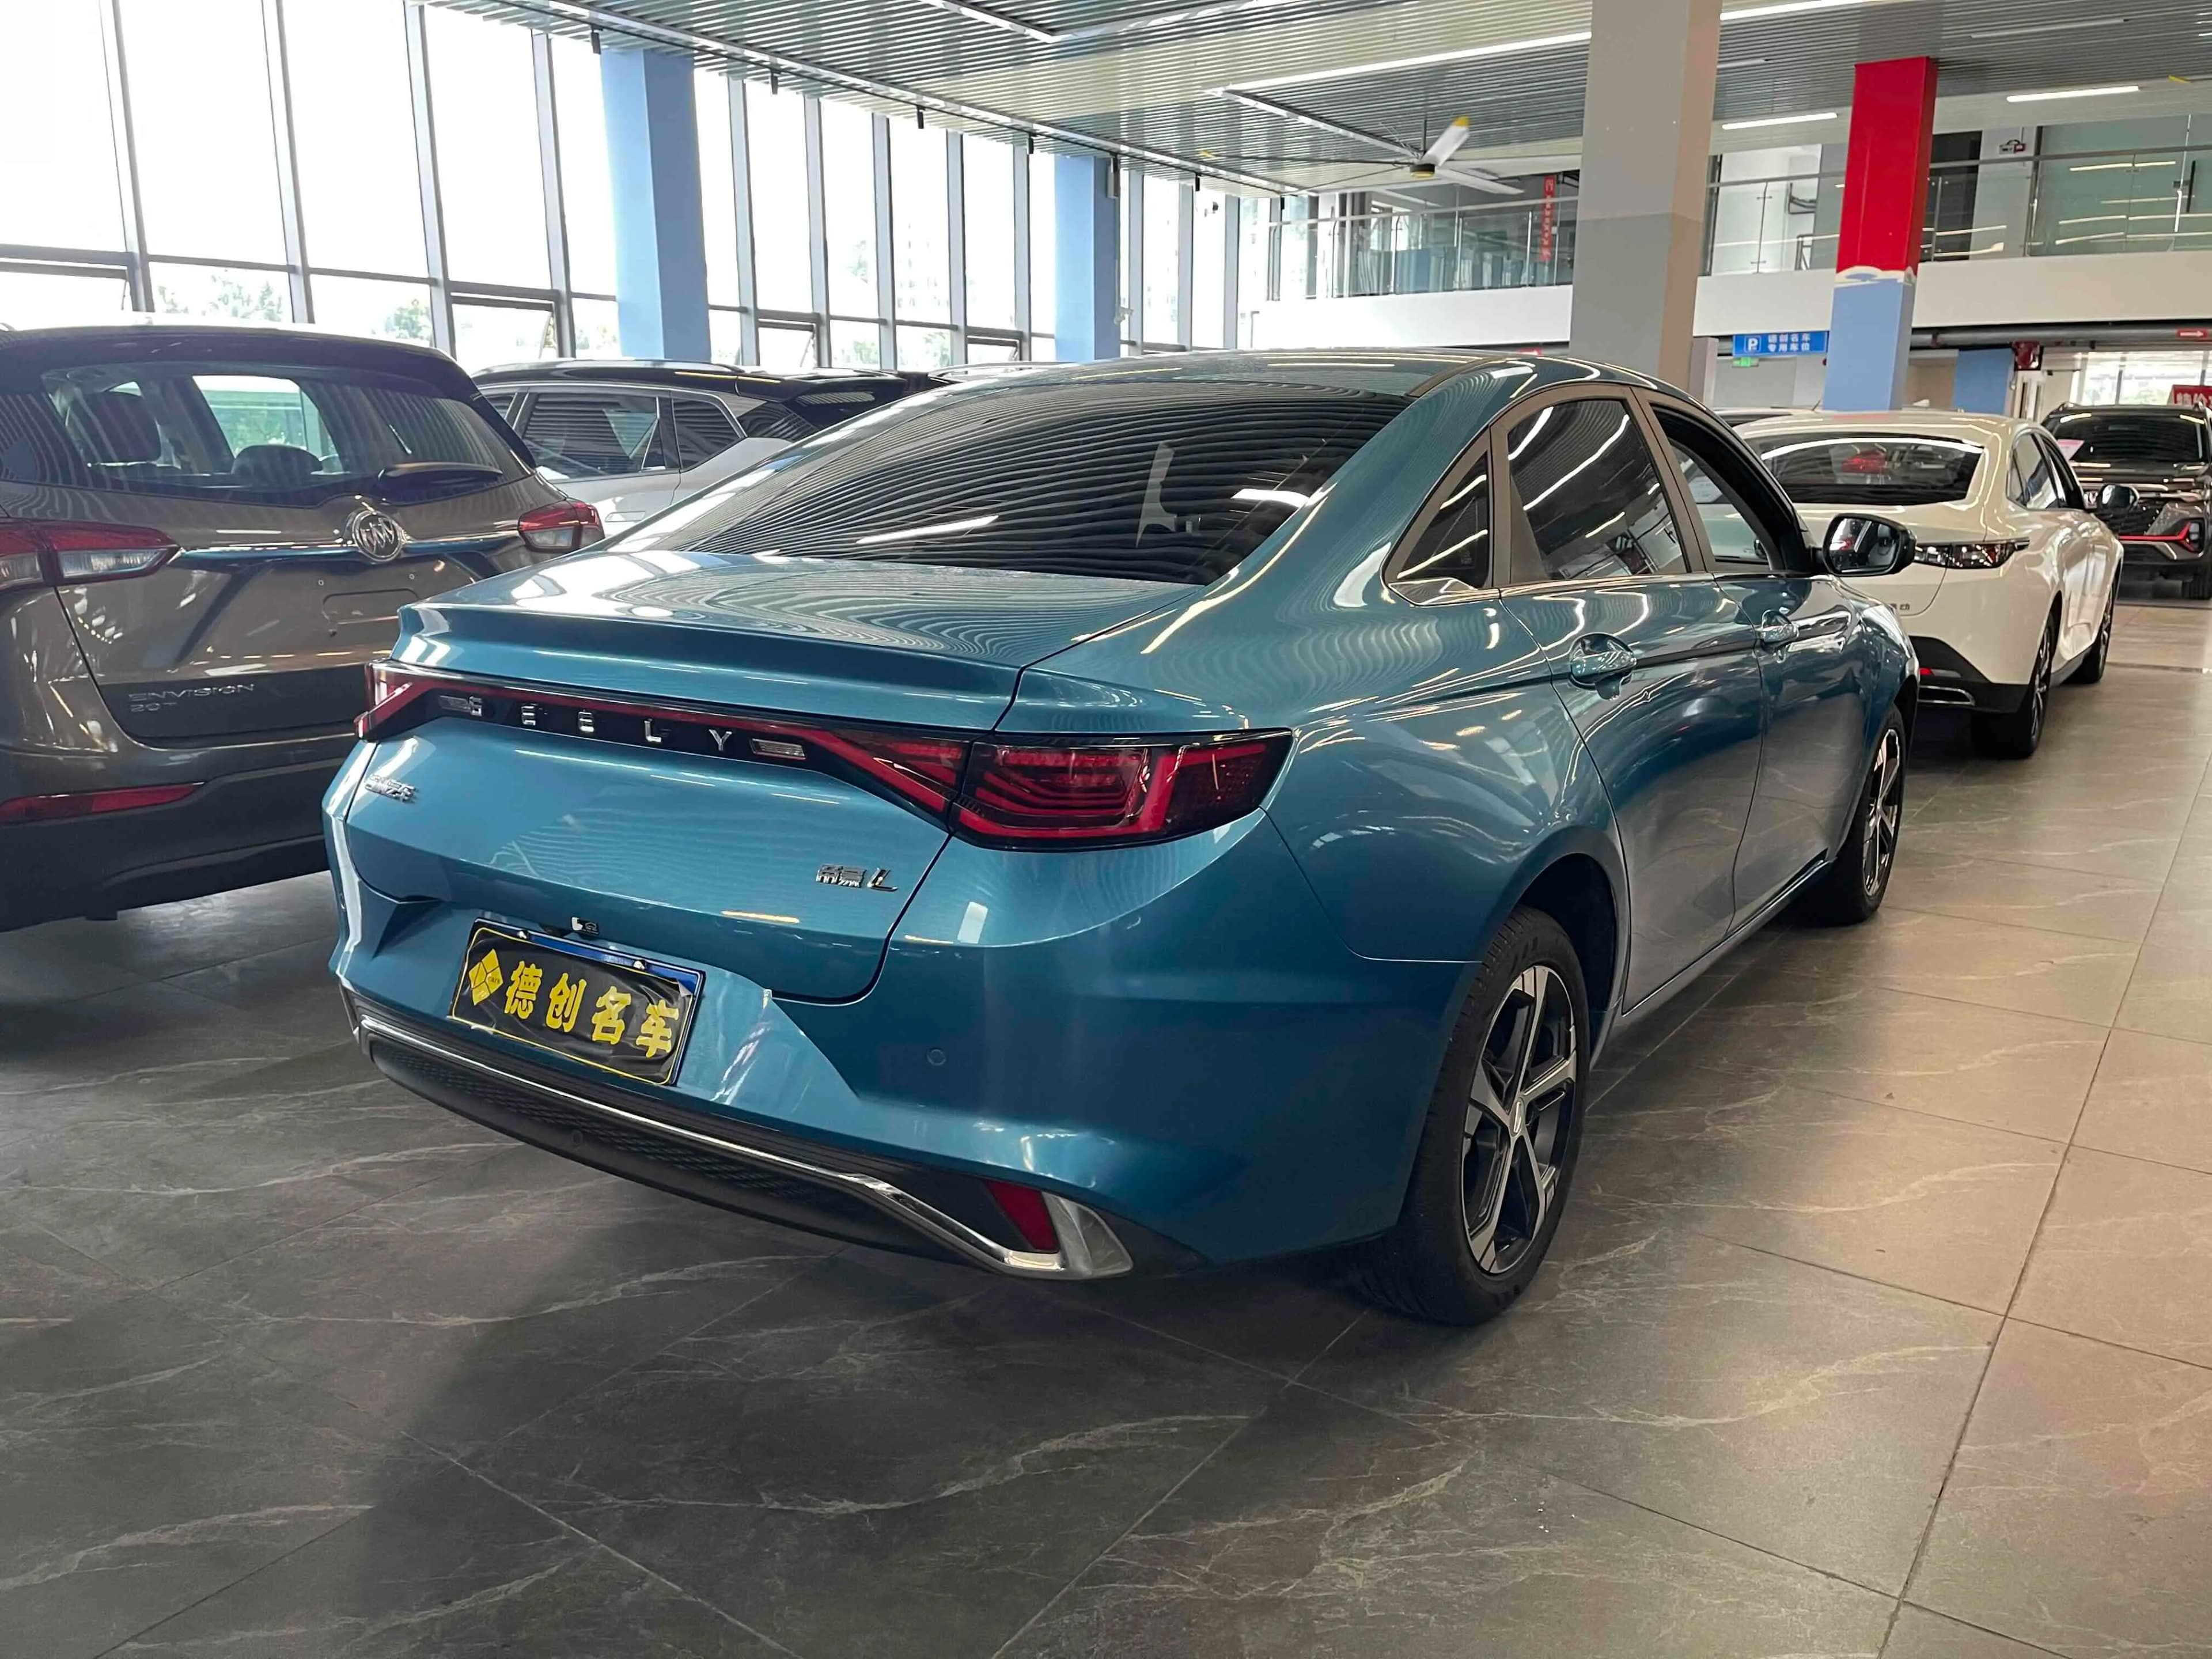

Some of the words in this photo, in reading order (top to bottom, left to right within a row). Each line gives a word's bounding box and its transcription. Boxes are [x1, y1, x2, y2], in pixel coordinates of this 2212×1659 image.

[1748, 338, 1758, 351] P
[128, 684, 255, 702] ENVISION
[469, 696, 732, 751] GEELY
[504, 960, 679, 1058] 德创名车
